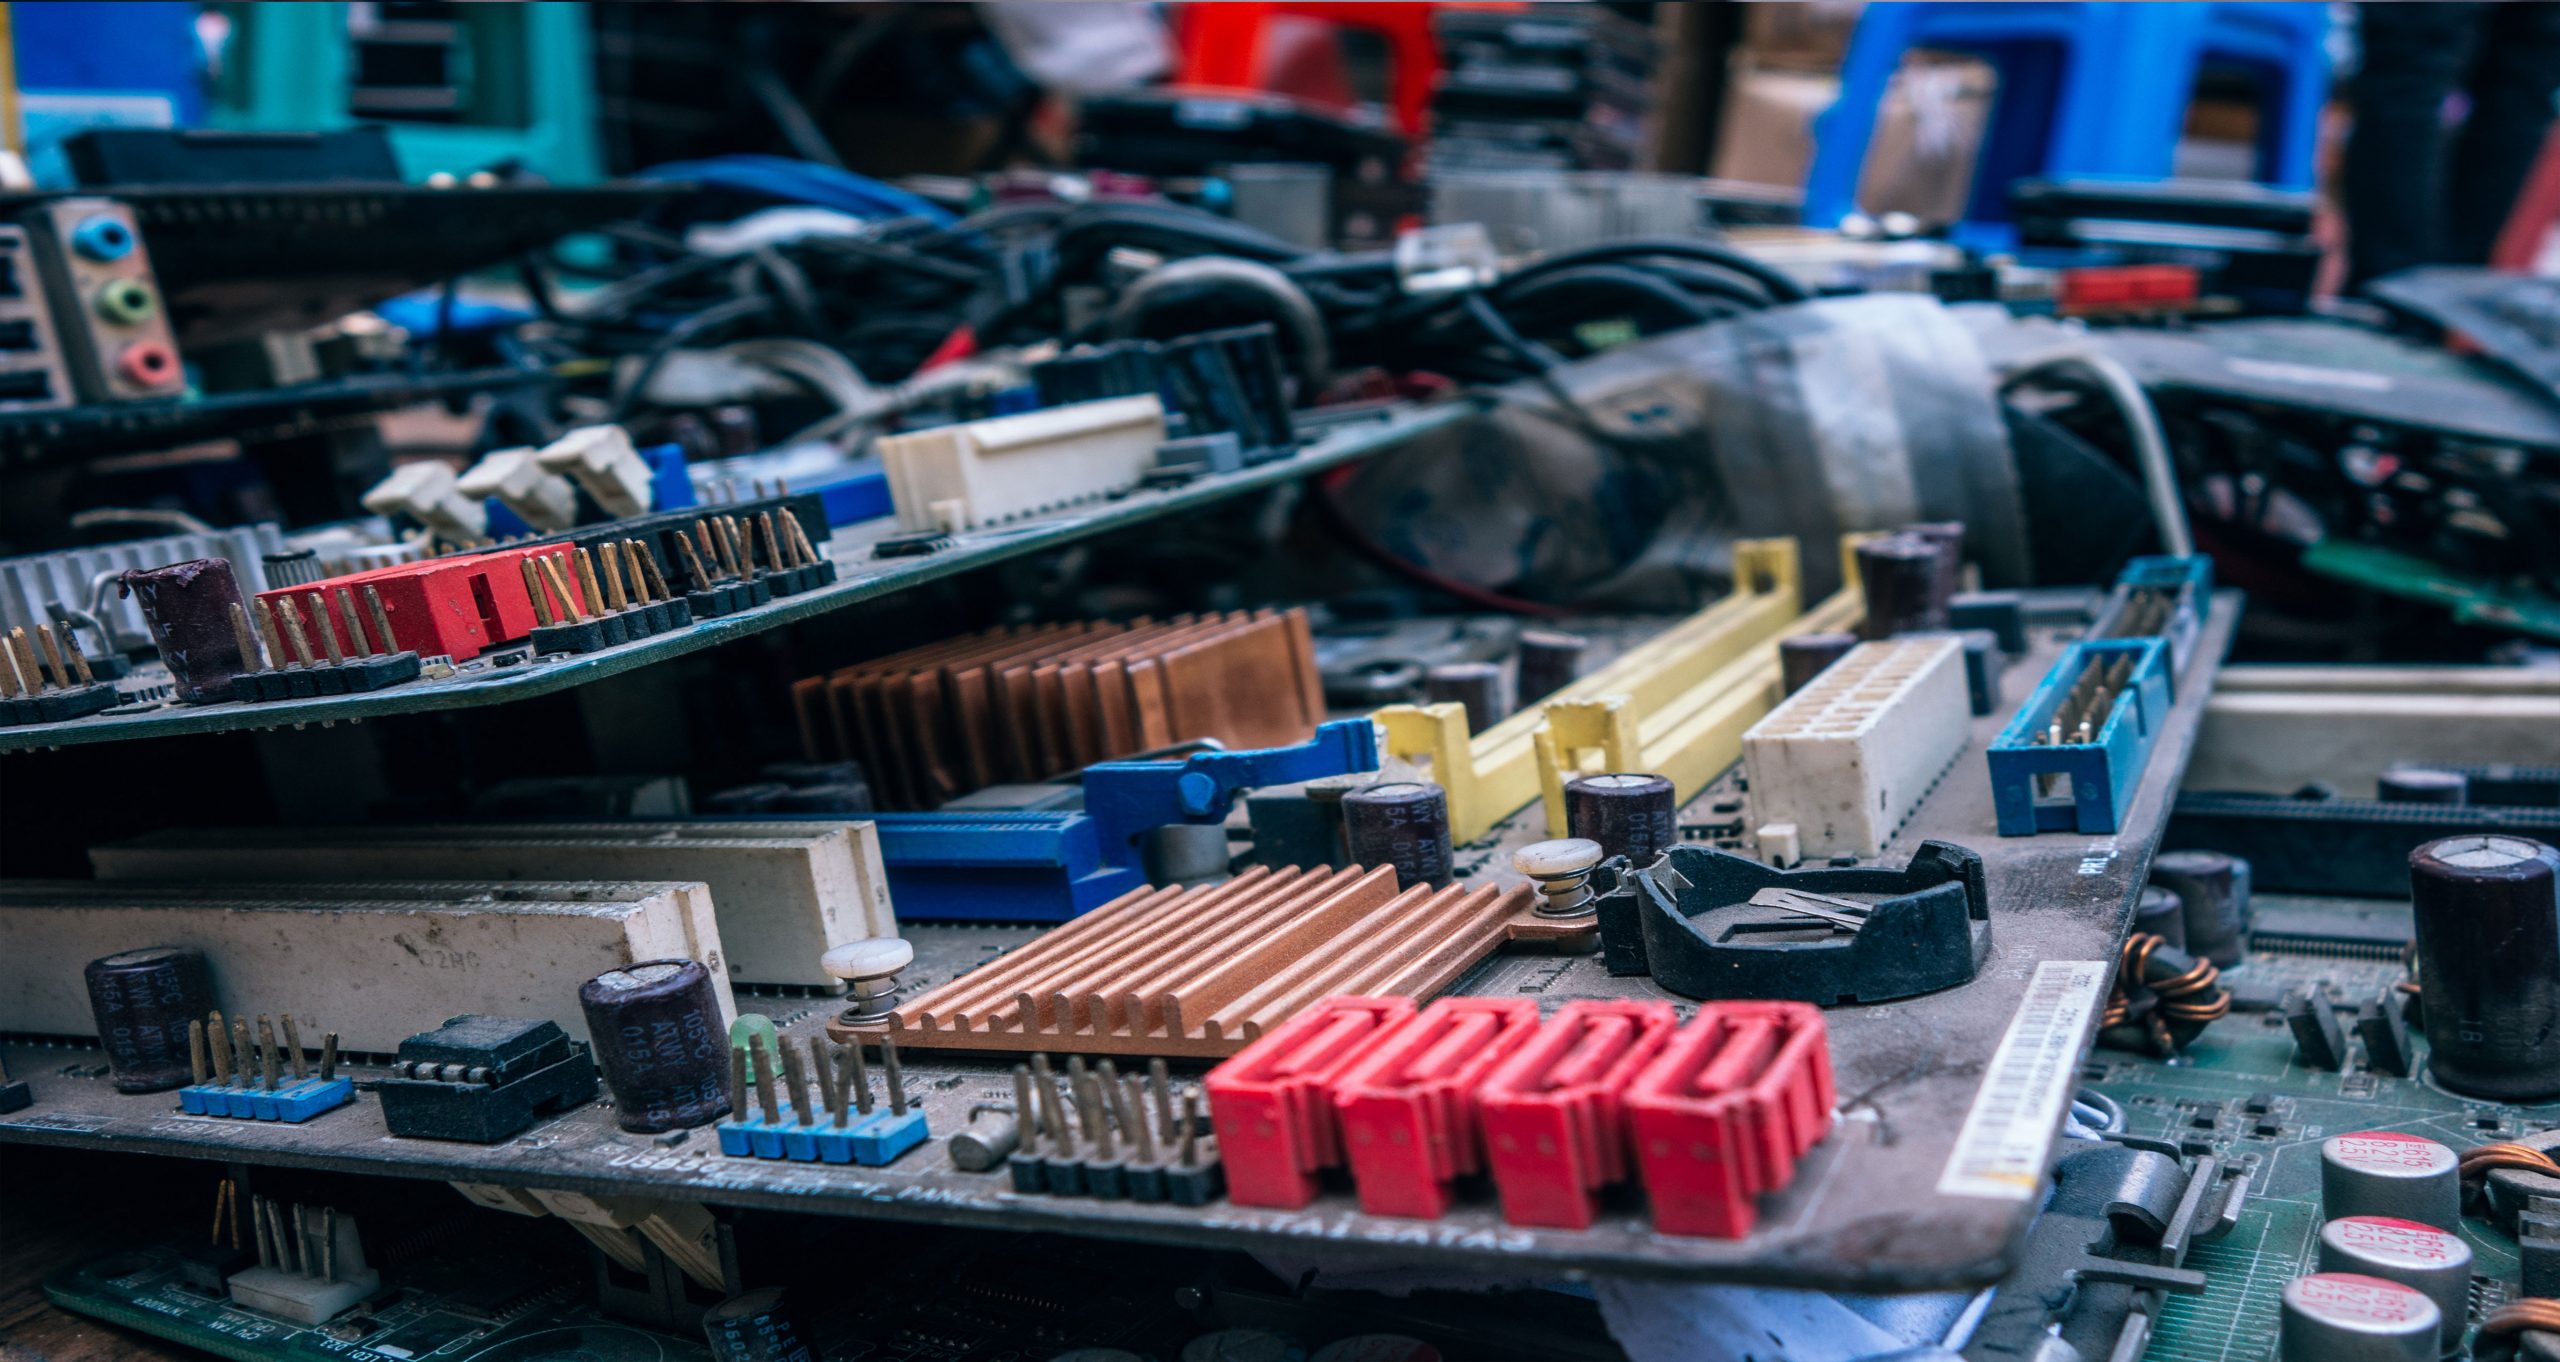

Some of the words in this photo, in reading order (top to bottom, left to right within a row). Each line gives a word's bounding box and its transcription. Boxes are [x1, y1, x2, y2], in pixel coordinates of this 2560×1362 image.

[623, 1025, 657, 1075] 015A
[651, 1021, 689, 1068] ATWY
[207, 1320, 236, 1333] FAN
[232, 1327, 262, 1341] CPU
